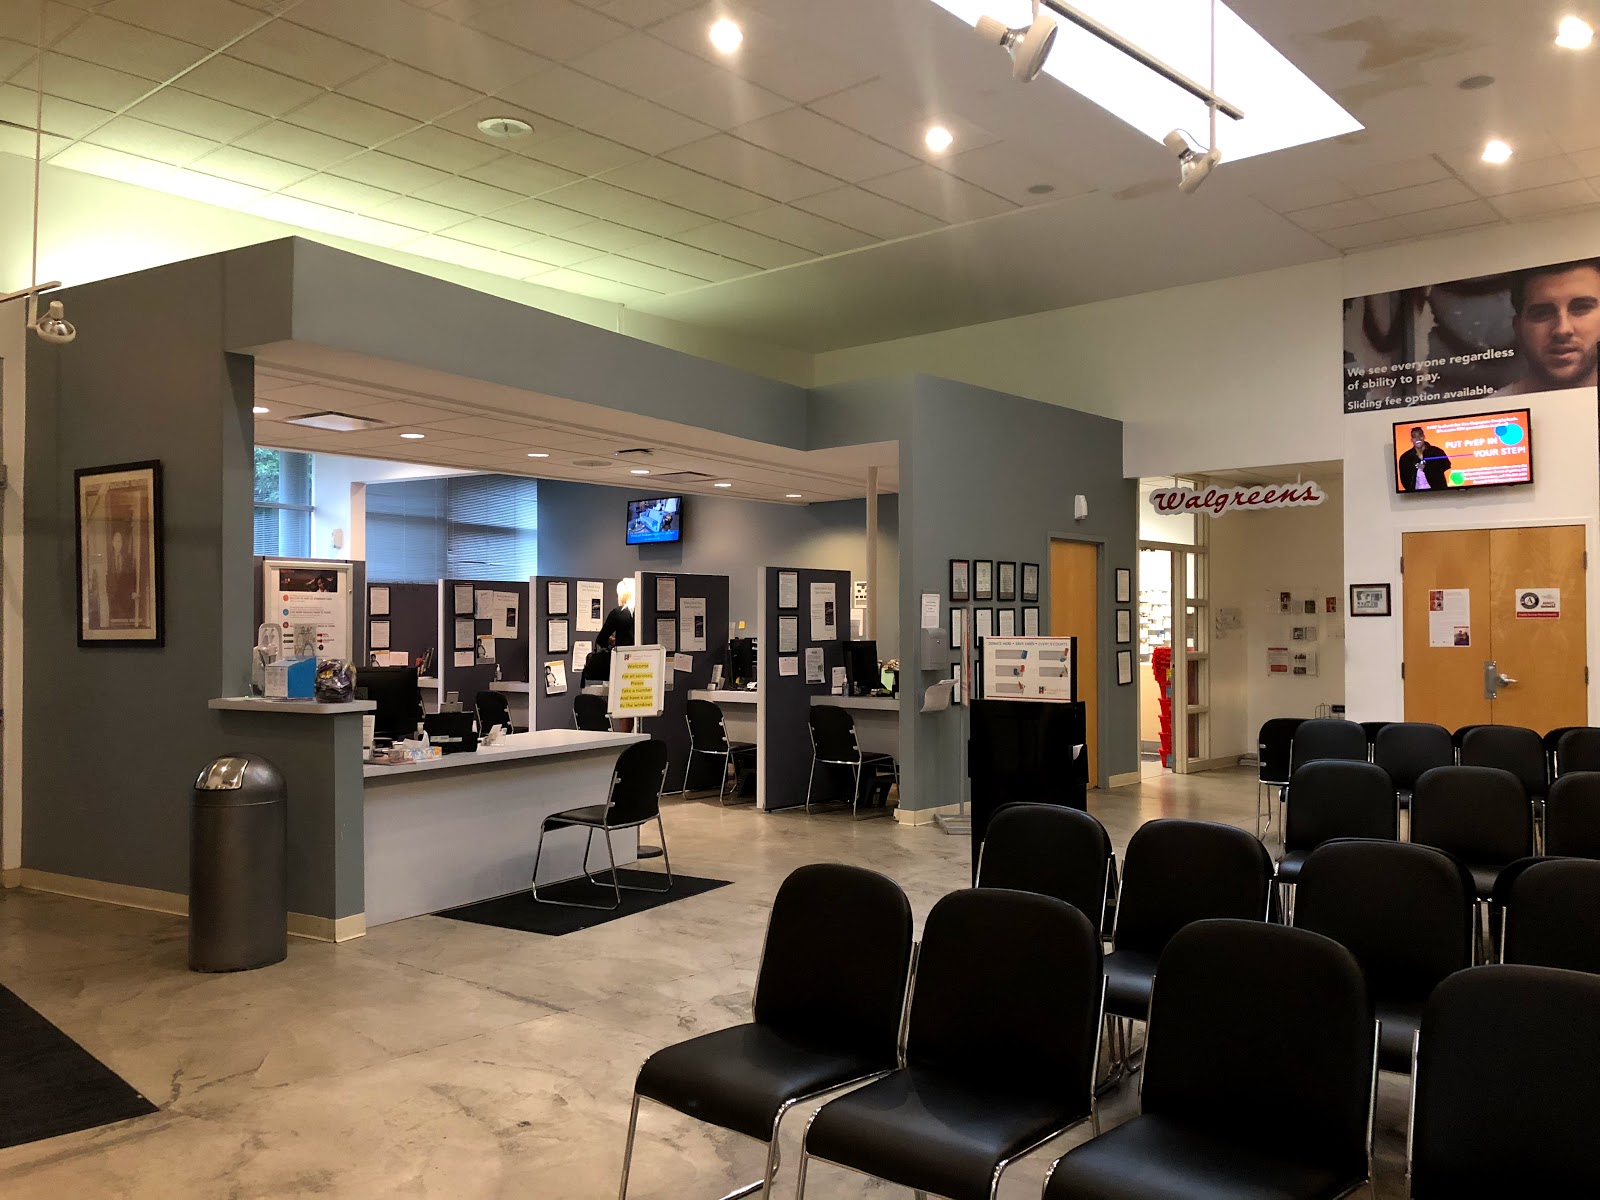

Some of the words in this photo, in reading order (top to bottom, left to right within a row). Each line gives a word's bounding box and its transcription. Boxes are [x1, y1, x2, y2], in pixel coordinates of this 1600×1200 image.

[1347, 367, 1365, 377] We
[1368, 366, 1388, 375] see
[1391, 358, 1446, 372] everyone
[1450, 349, 1514, 365] regardless
[1347, 380, 1359, 390] of
[1362, 377, 1397, 388] ability
[1400, 375, 1413, 384] to
[1416, 372, 1440, 384] pay.
[1347, 399, 1382, 410] Sliding
[1385, 396, 1402, 406] fee
[1405, 392, 1440, 404] option
[1443, 385, 1497, 399] available.
[1445, 440, 1462, 449] PUT
[1464, 438, 1485, 447] PrEP
[1487, 437, 1498, 445] IN
[1473, 448, 1499, 458] YOUR
[1501, 446, 1526, 455] STEP!
[1153, 486, 1320, 514] Walgreens
